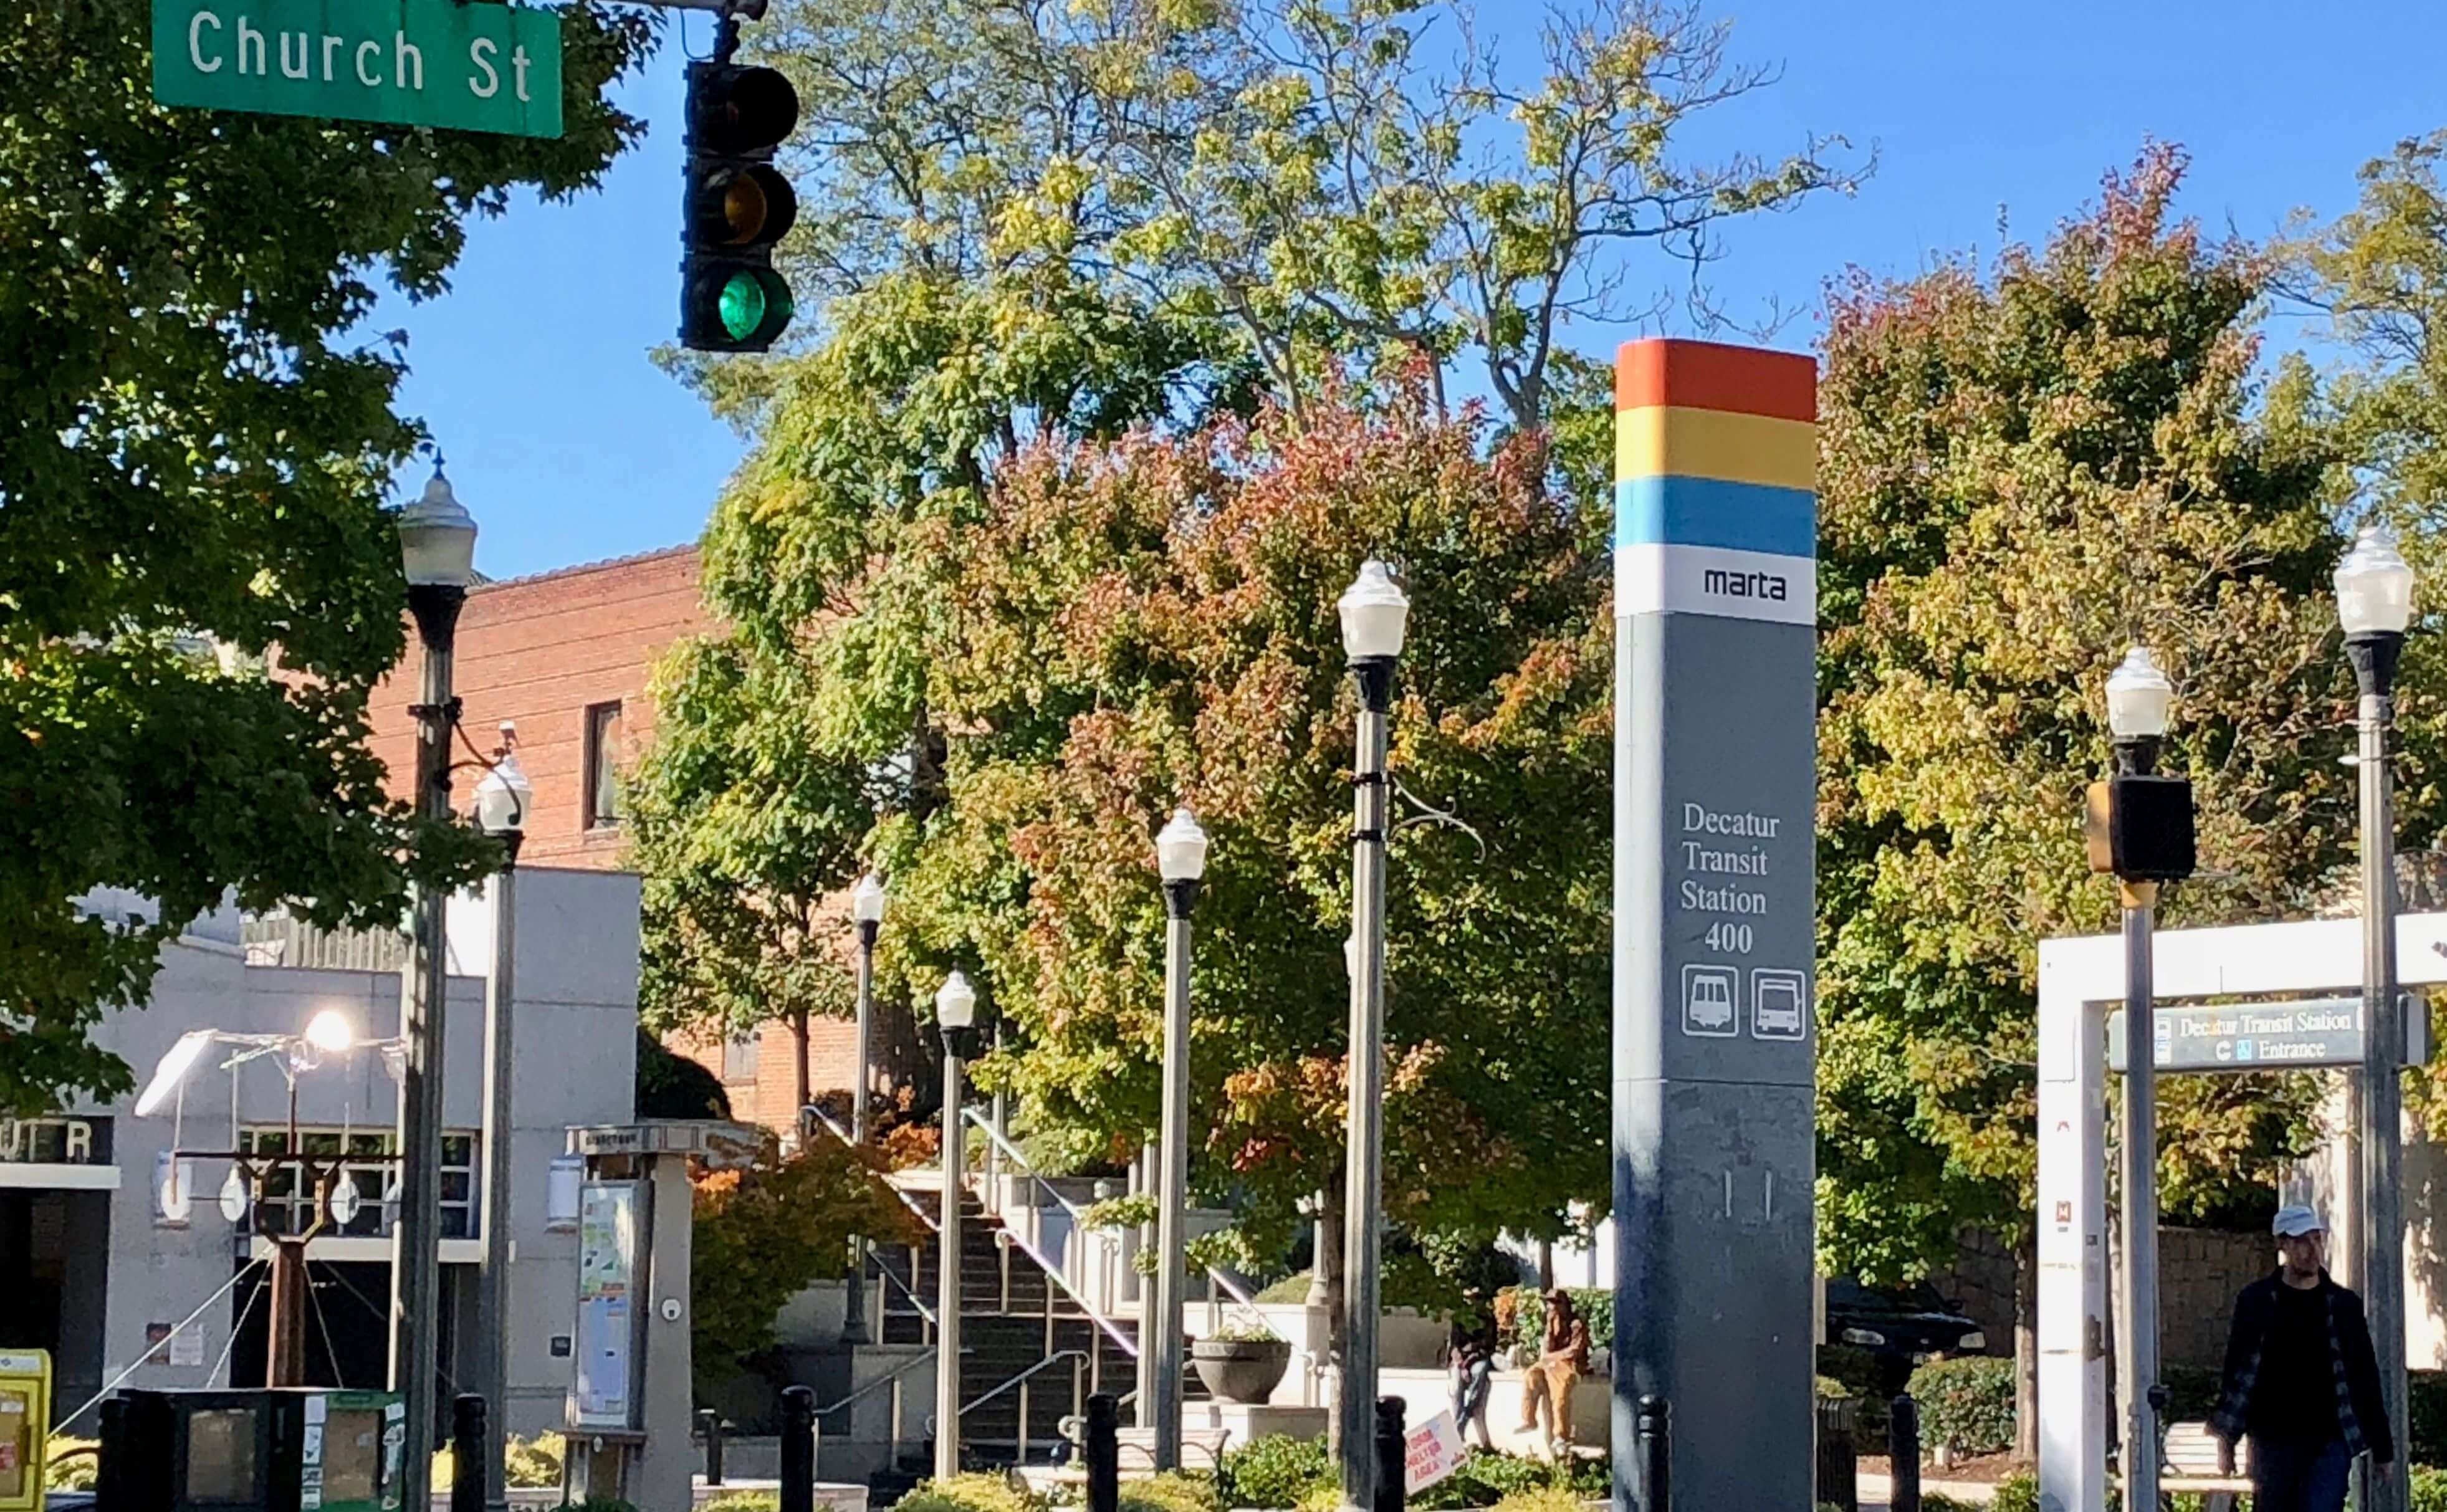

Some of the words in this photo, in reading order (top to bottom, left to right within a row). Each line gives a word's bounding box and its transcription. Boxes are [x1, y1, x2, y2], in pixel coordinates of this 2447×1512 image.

[189, 10, 423, 90] Church
[468, 36, 532, 102] St
[1704, 569, 1786, 601] marta
[1682, 802, 1781, 838] Decatur
[1682, 841, 1769, 875] Transit
[1680, 879, 1766, 915] Station
[1705, 922, 1753, 954] 400
[2180, 1018, 2238, 1037] Decatur
[2239, 1012, 2292, 1033] Transit
[2296, 1010, 2352, 1032] Station
[2258, 1040, 2326, 1060] Entrance
